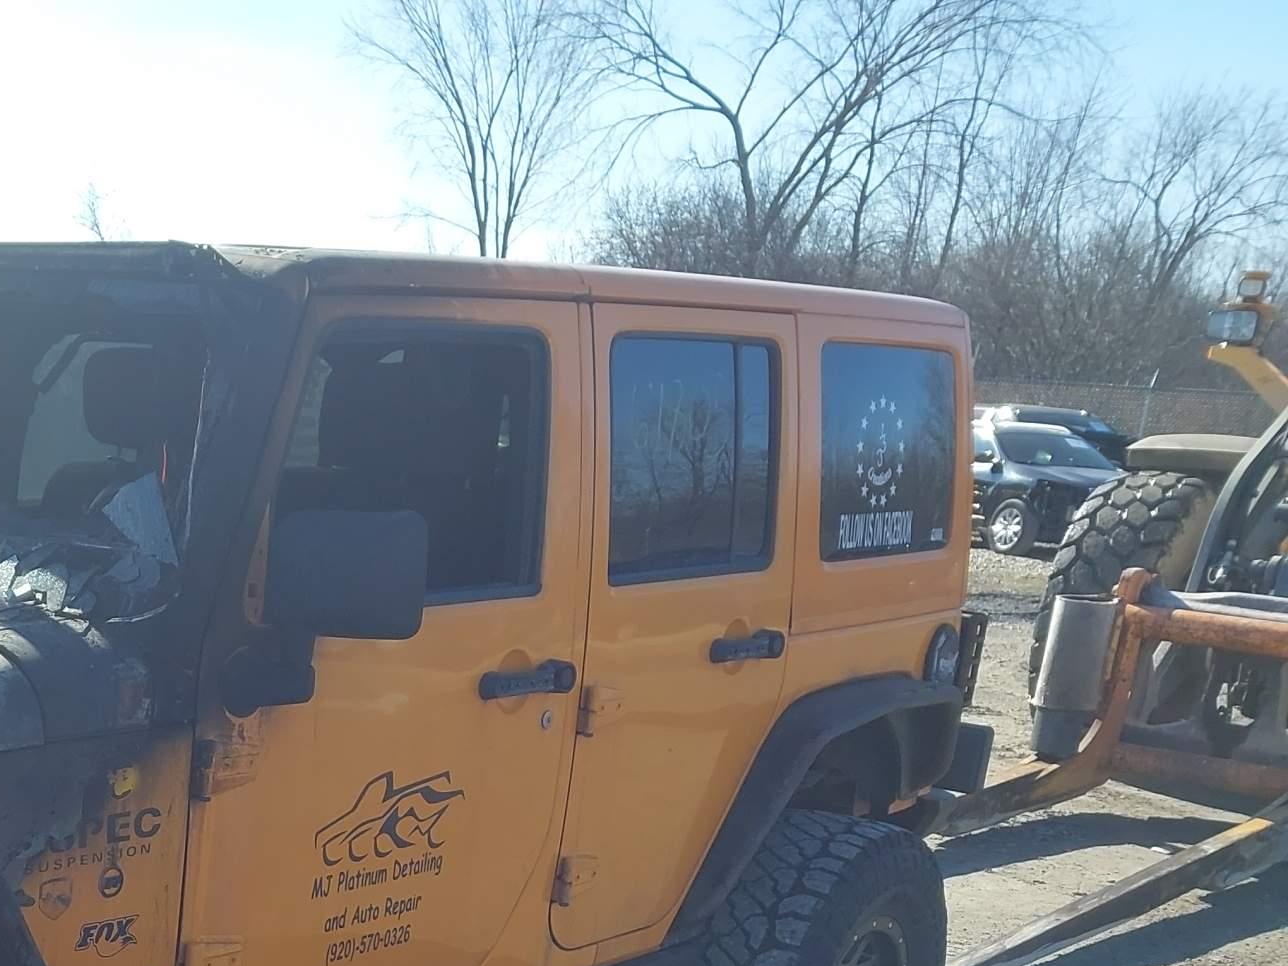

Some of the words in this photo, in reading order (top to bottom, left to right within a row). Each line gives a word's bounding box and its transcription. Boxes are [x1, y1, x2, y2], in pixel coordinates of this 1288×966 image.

[838, 514, 866, 550] FOLLOW
[864, 512, 874, 547] US
[873, 512, 884, 547] ON
[311, 875, 333, 899] MJ
[337, 868, 388, 892] Platinum
[392, 852, 443, 881] Detailing
[324, 907, 347, 932] and
[351, 904, 380, 925] Auto
[384, 894, 422, 920] Repair
[75, 914, 140, 956] FOX
